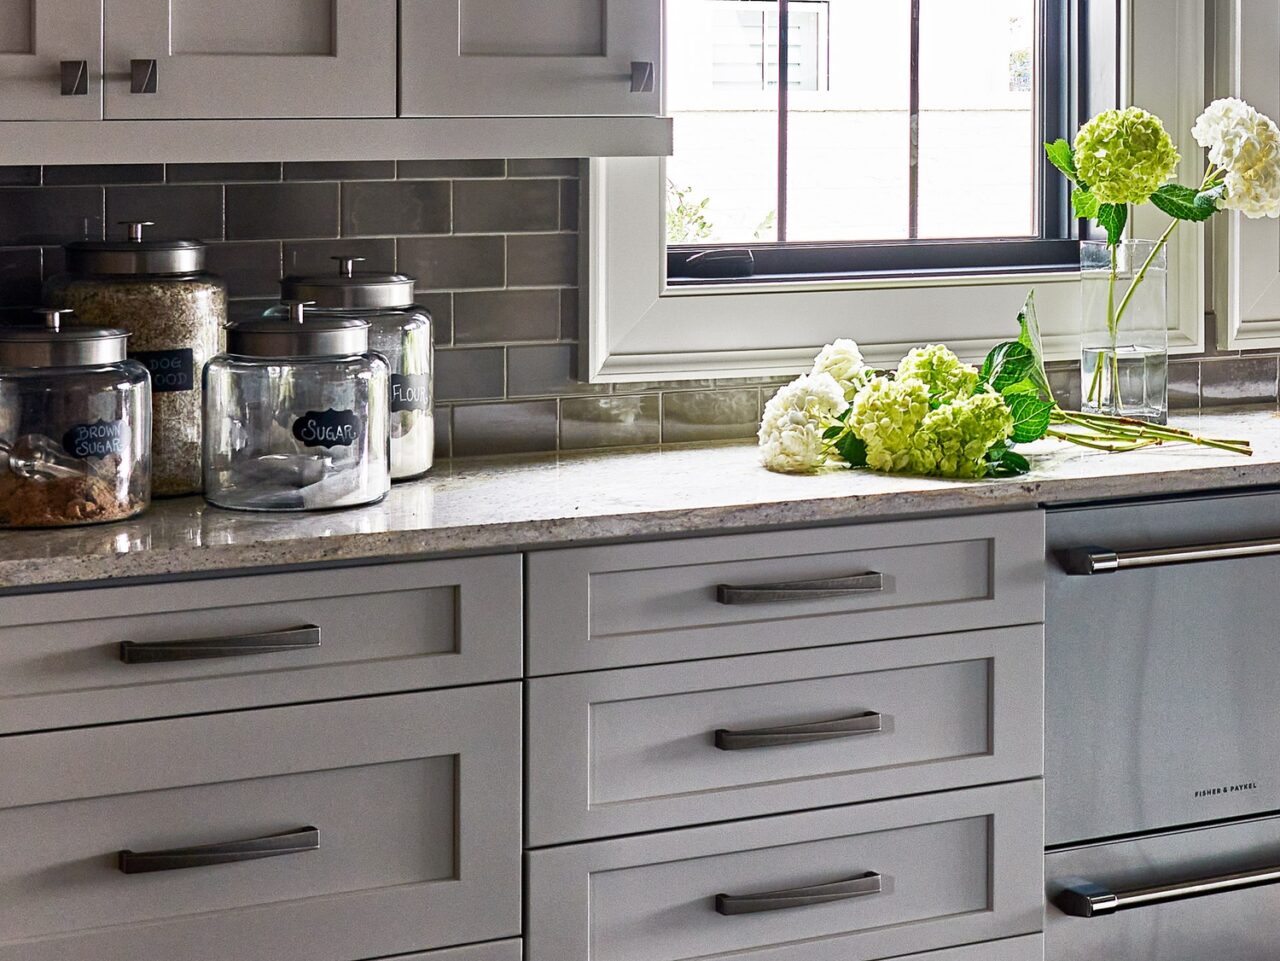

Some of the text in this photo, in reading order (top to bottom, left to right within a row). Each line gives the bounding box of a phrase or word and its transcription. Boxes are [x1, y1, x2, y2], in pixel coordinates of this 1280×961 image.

[149, 357, 182, 370] DOG
[154, 372, 187, 386] OOD
[392, 384, 428, 405] FLOUR
[76, 424, 121, 441] BROWN
[301, 419, 357, 442] SUGAR
[75, 438, 124, 456] SUGAR
[1194, 788, 1221, 797] FISHER
[1230, 783, 1256, 792] PAYKEL
